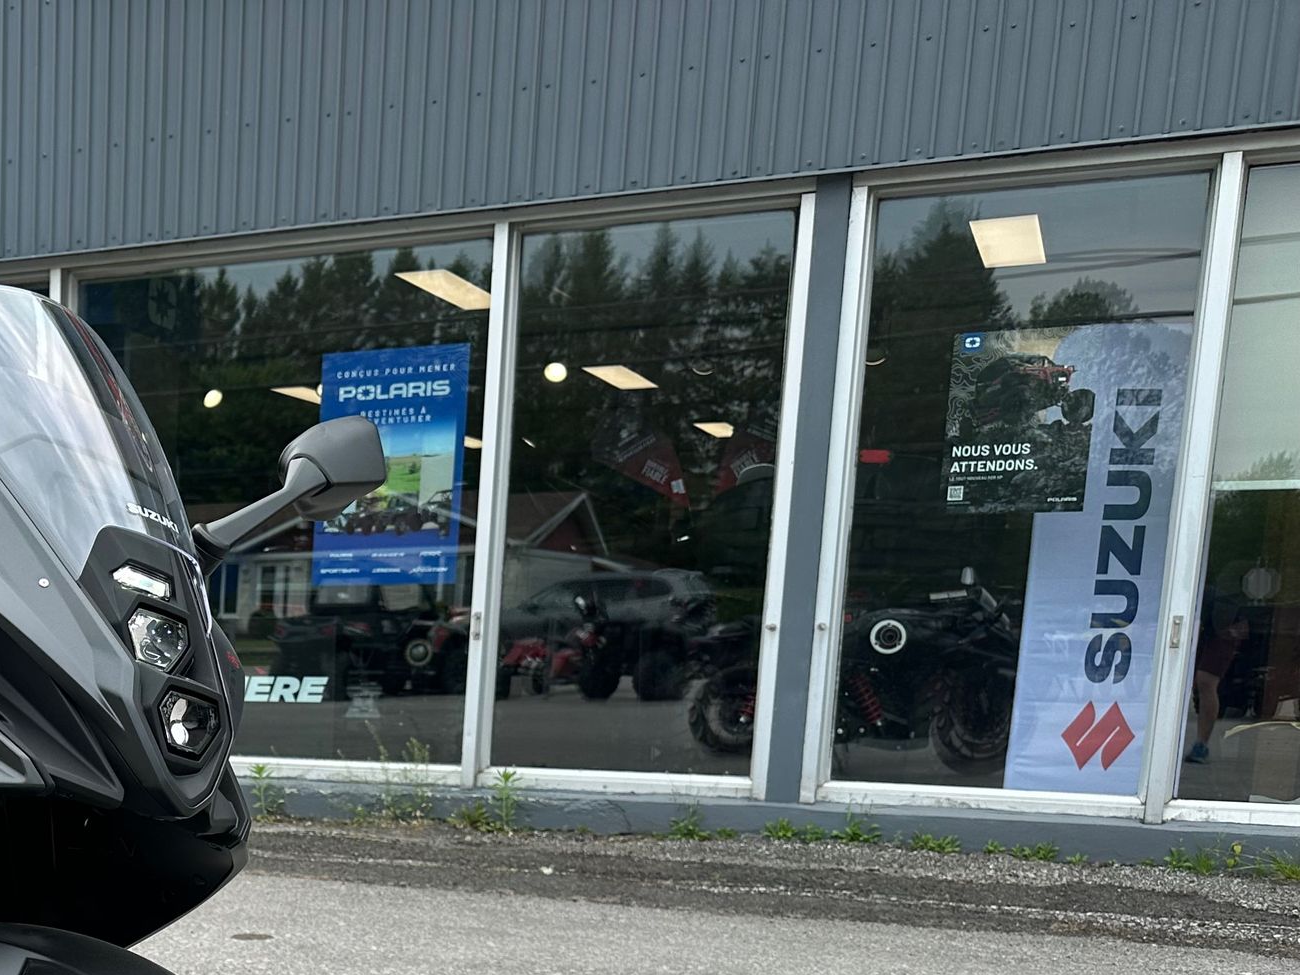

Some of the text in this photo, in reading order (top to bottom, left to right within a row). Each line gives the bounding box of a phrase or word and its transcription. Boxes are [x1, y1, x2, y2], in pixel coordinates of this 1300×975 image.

[336, 363, 457, 380] CONÇUS POUR MENER
[338, 379, 451, 403] POLARIS
[951, 443, 1031, 457] NOUS VOUS
[950, 459, 1039, 473] ATTENDONS.
[126, 502, 179, 533] SUZUKI
[1084, 388, 1162, 684] SUZUKI
[243, 666, 329, 703] ÈRE
